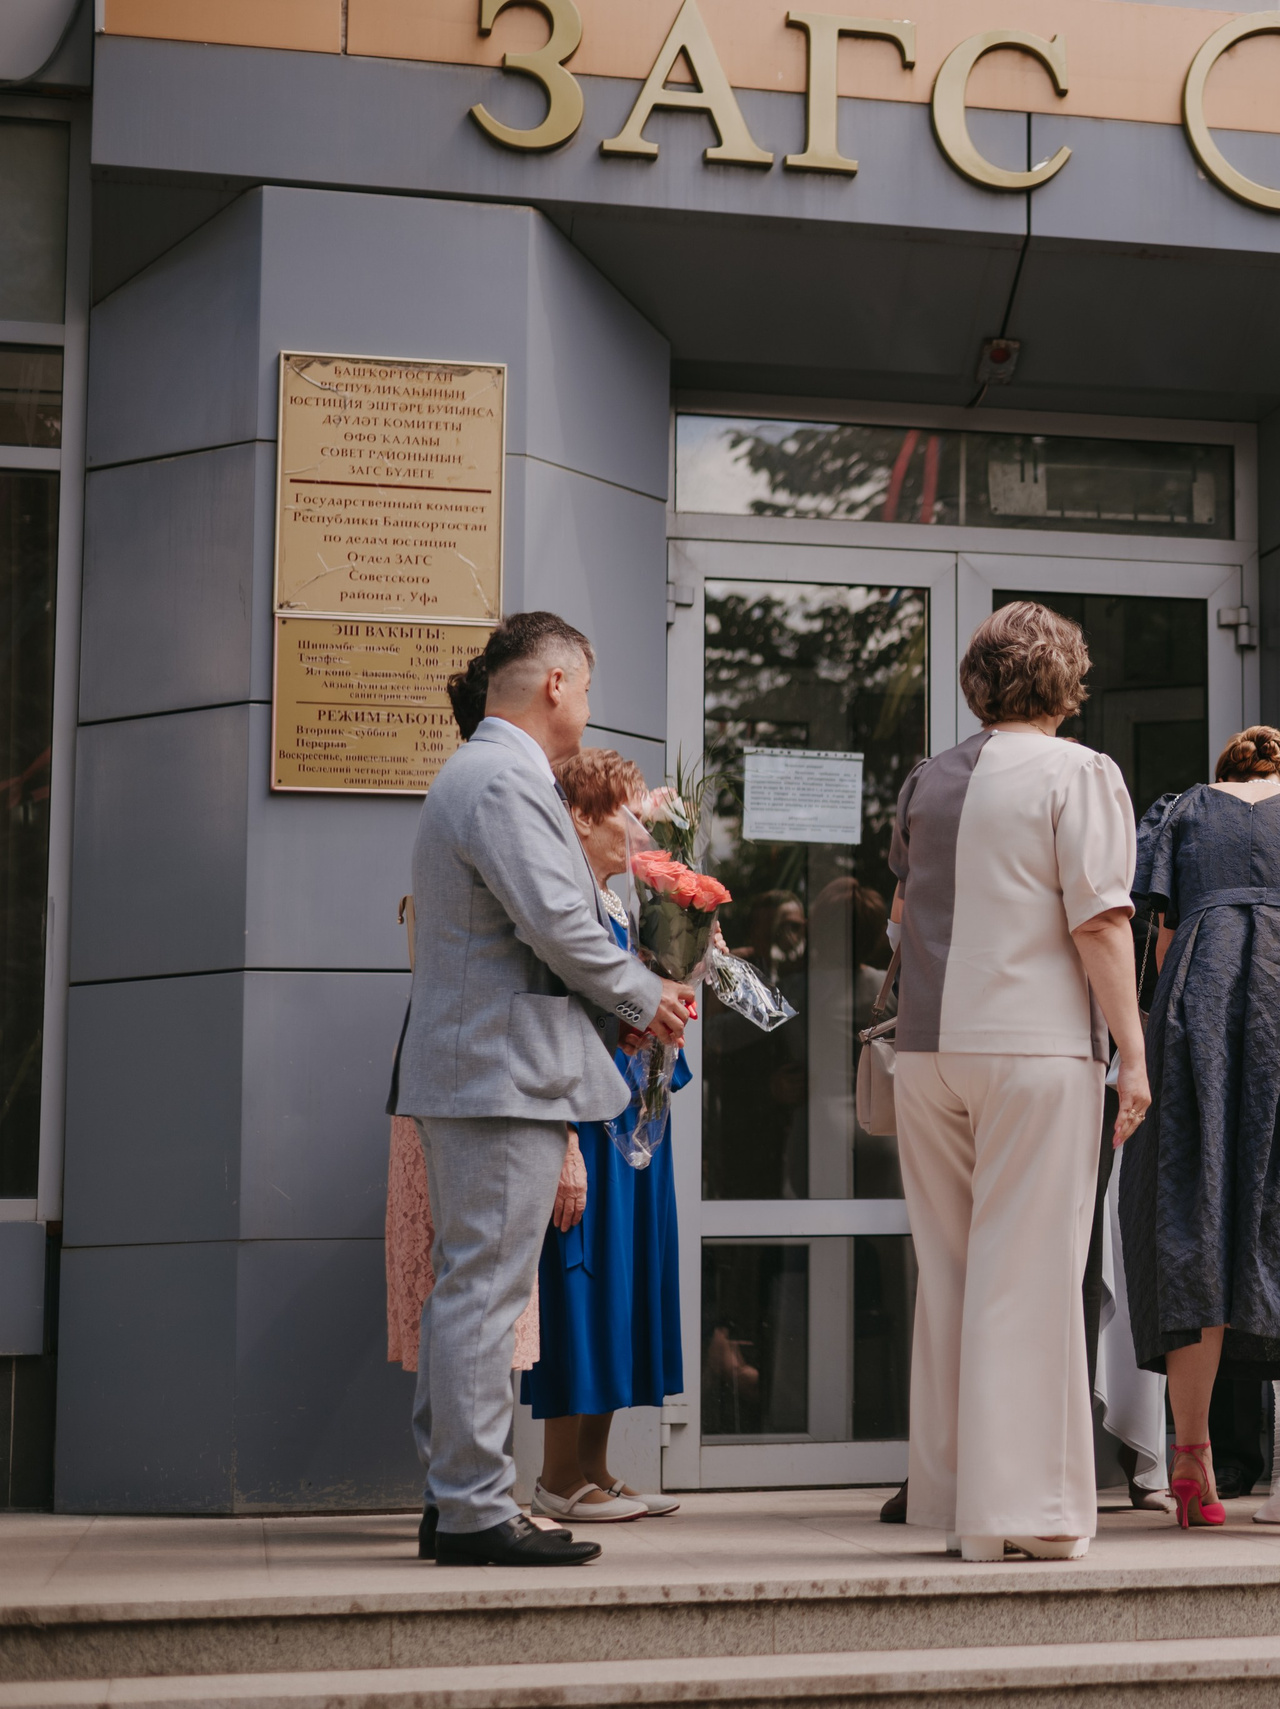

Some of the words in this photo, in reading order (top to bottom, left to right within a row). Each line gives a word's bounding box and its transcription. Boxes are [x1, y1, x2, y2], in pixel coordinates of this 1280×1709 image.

[469, 0, 1073, 192] ЗАГС
[290, 396, 363, 410] ЮСТИЦИЯ
[427, 404, 495, 418] БУЙЫНСА
[383, 418, 462, 431] КОМИТЕТЫ
[320, 447, 365, 459] СОВЕТ
[348, 465, 382, 476] ЗАГС
[295, 493, 422, 511] Государственный
[426, 503, 486, 514] комитет
[293, 511, 378, 527] Республики
[383, 516, 487, 532] Башкортостан
[323, 534, 342, 543] по
[345, 535, 388, 546] делам
[392, 538, 457, 549] юстиции
[347, 551, 390, 564] Отдел
[395, 553, 433, 566] ЗАГС
[349, 570, 430, 584] Советского
[340, 590, 392, 602] района
[396, 593, 405, 602] г.
[410, 591, 438, 606] Уфа
[332, 623, 360, 636] ЭШ
[416, 643, 439, 654] 9.00
[451, 645, 480, 655] 18.00
[410, 657, 439, 667] 13.00
[317, 709, 381, 723] РЕЖИМ
[296, 725, 345, 737] Вторник
[355, 728, 397, 739] суббота
[419, 729, 443, 740] 9.00
[296, 737, 347, 750] Перерыв
[415, 741, 444, 752] 13.00
[279, 750, 343, 762] Воскресенье,
[346, 754, 409, 765] понедельник
[423, 757, 447, 765] выхо
[298, 764, 351, 775] Последний
[354, 767, 392, 776] четверг
[395, 769, 435, 777] каждого
[344, 778, 404, 788] санитарный
